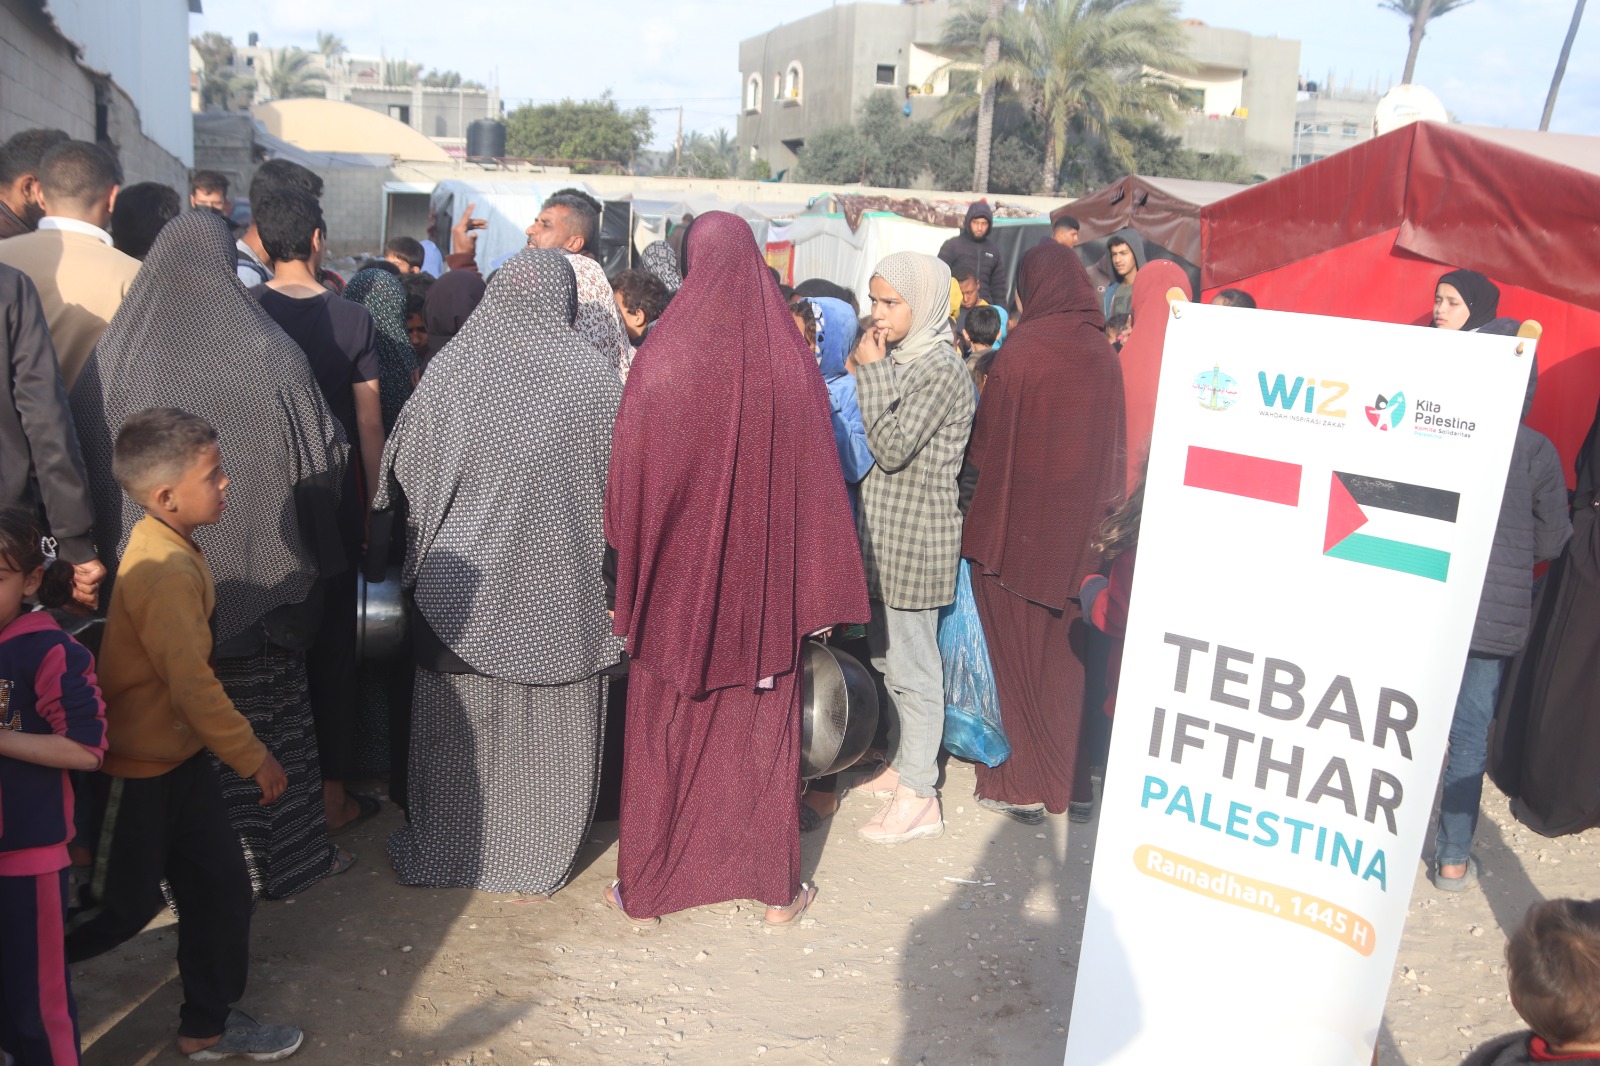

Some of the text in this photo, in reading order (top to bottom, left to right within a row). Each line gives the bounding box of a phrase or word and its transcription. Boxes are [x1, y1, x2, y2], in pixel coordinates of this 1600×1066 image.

[1258, 371, 1349, 418] WiZ
[1416, 399, 1441, 413] Kita
[1258, 410, 1288, 419] WAHDAH
[1322, 420, 1346, 429] ZAKAT
[1415, 412, 1475, 431] Palestina
[1438, 428, 1471, 438] Solidaritas
[1164, 632, 1419, 761] TEBAR
[1148, 706, 1404, 836] IFTHAR
[1141, 775, 1387, 892] PALESTINA
[1147, 850, 1368, 947] Ramadhan, 1445 H
